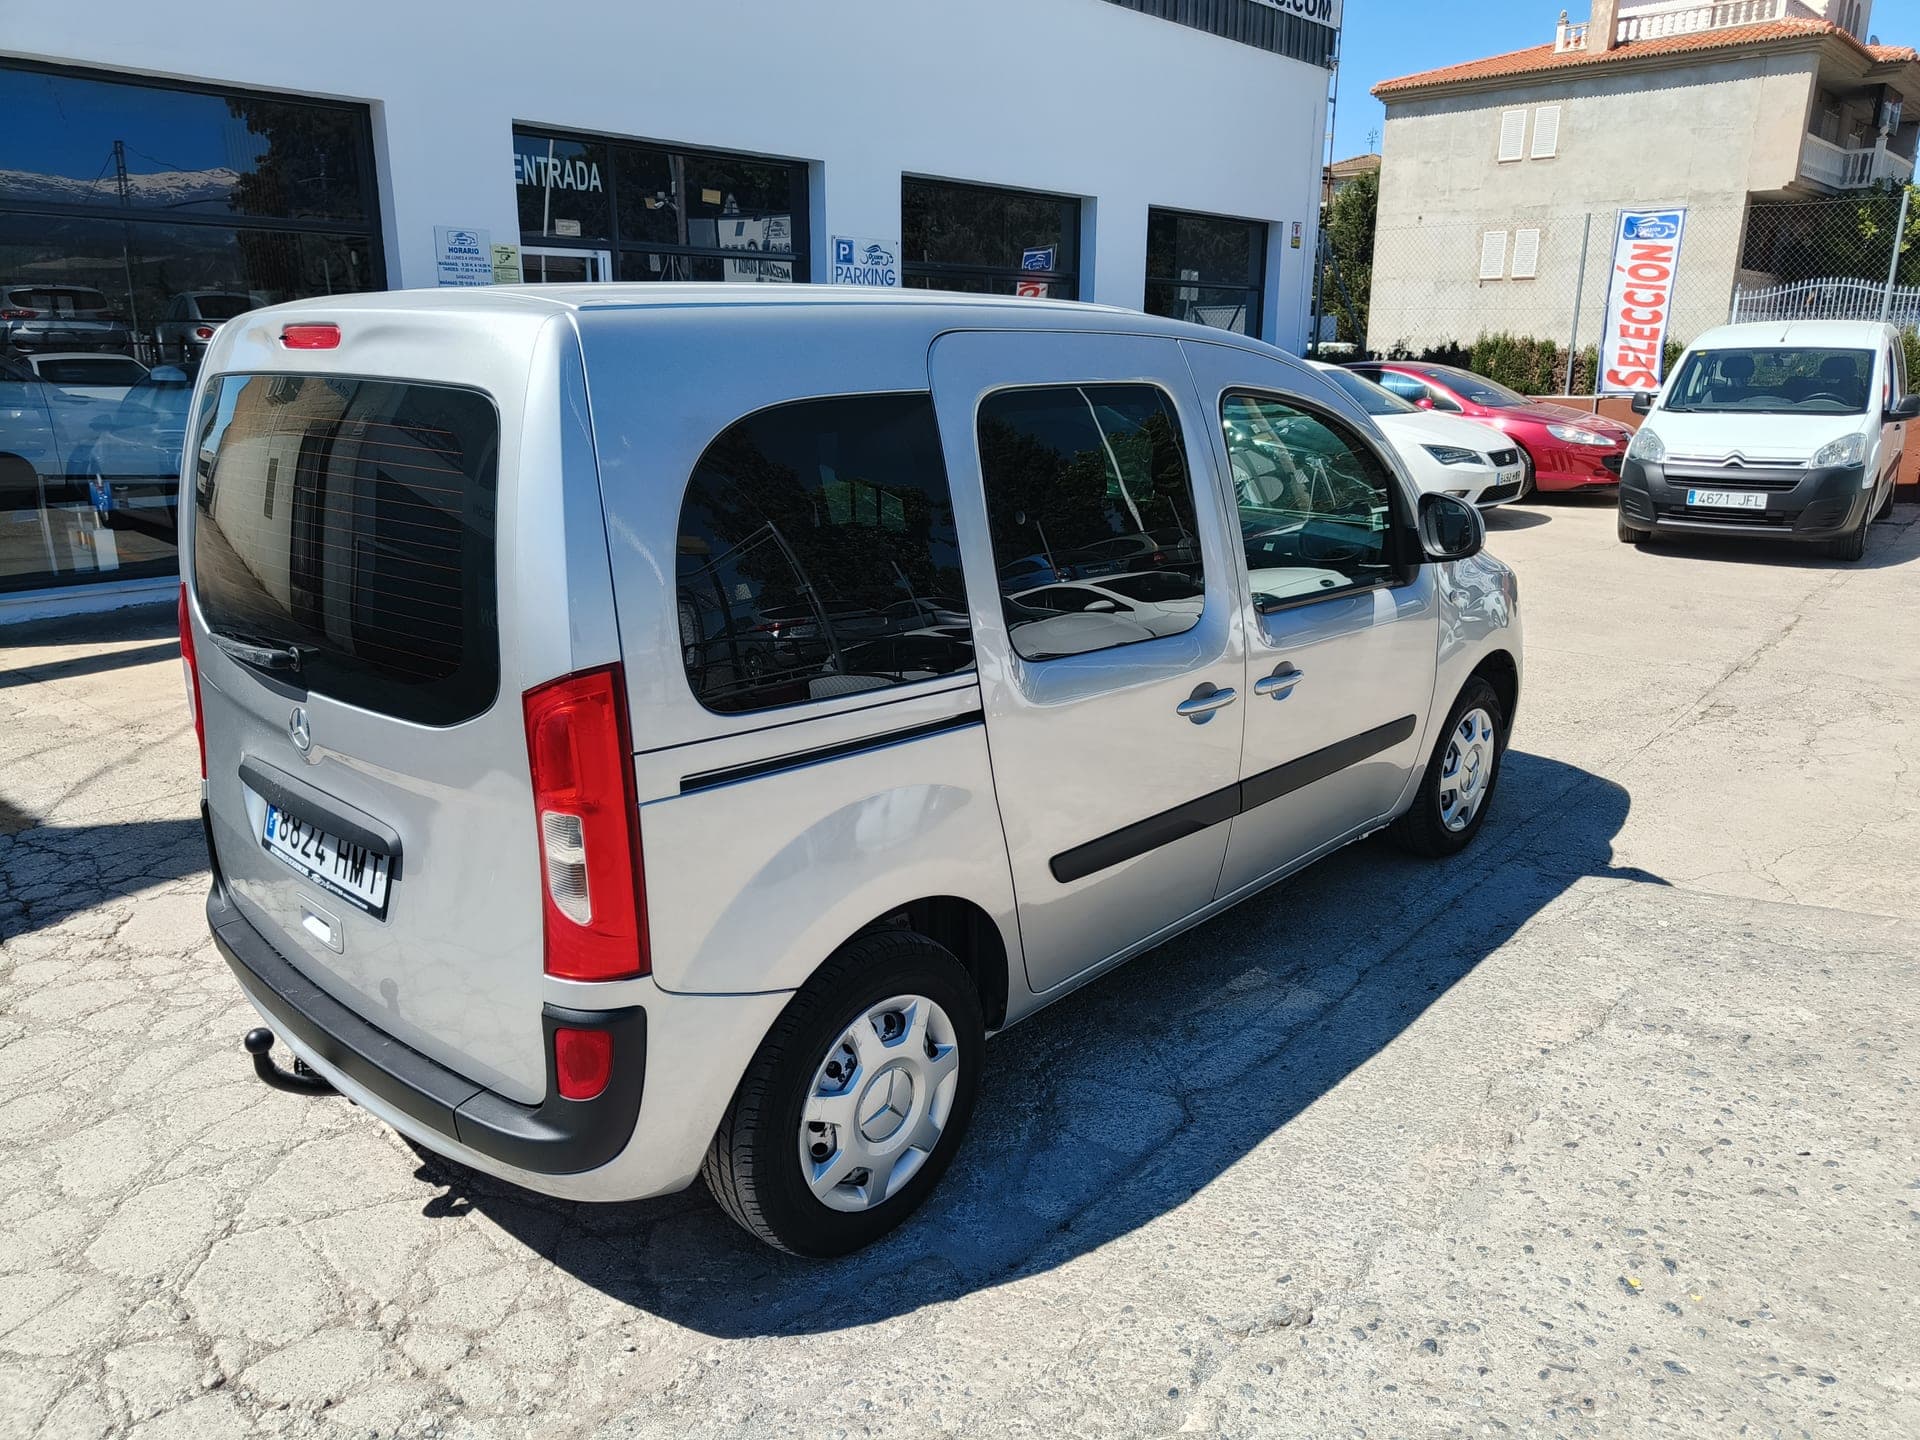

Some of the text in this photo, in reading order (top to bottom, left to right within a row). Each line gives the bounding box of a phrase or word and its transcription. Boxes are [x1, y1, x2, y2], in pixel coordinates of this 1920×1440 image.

[513, 153, 603, 193] ENTRADA
[448, 246, 480, 255] HORARIO
[840, 243, 850, 260] P
[835, 266, 896, 286] PARKING
[1606, 243, 1674, 389] SELECCIÓN
[1698, 493, 1763, 507] 4671 JFL
[279, 809, 326, 867] 8824
[334, 840, 384, 895] HMT
